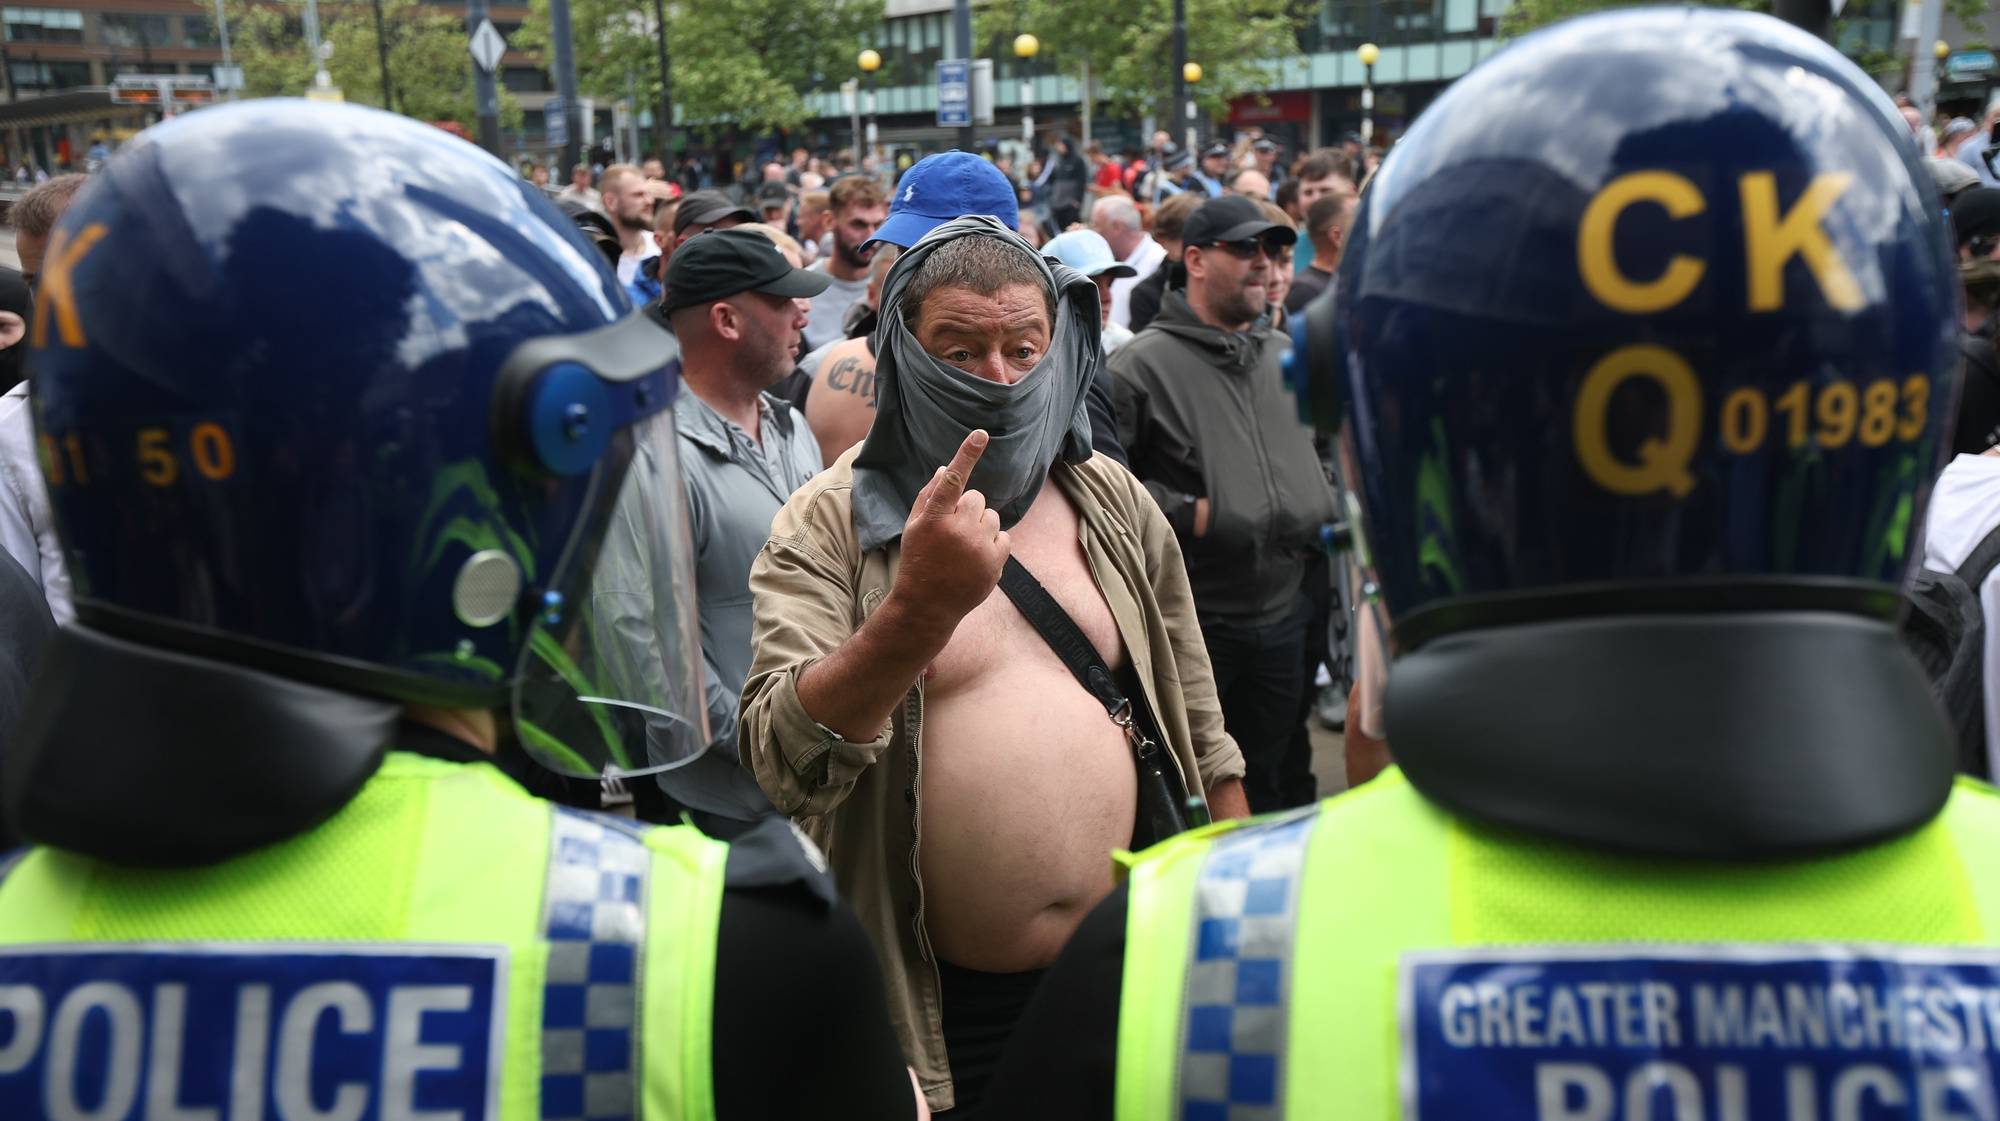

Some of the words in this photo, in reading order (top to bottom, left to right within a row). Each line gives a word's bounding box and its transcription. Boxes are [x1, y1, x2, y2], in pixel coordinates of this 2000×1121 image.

[31, 222, 109, 348] K
[1577, 169, 1869, 313] CK
[827, 356, 876, 408] En
[1573, 343, 1705, 498] Q
[1719, 373, 1931, 454] 01983
[1440, 983, 1681, 1048] GREATER
